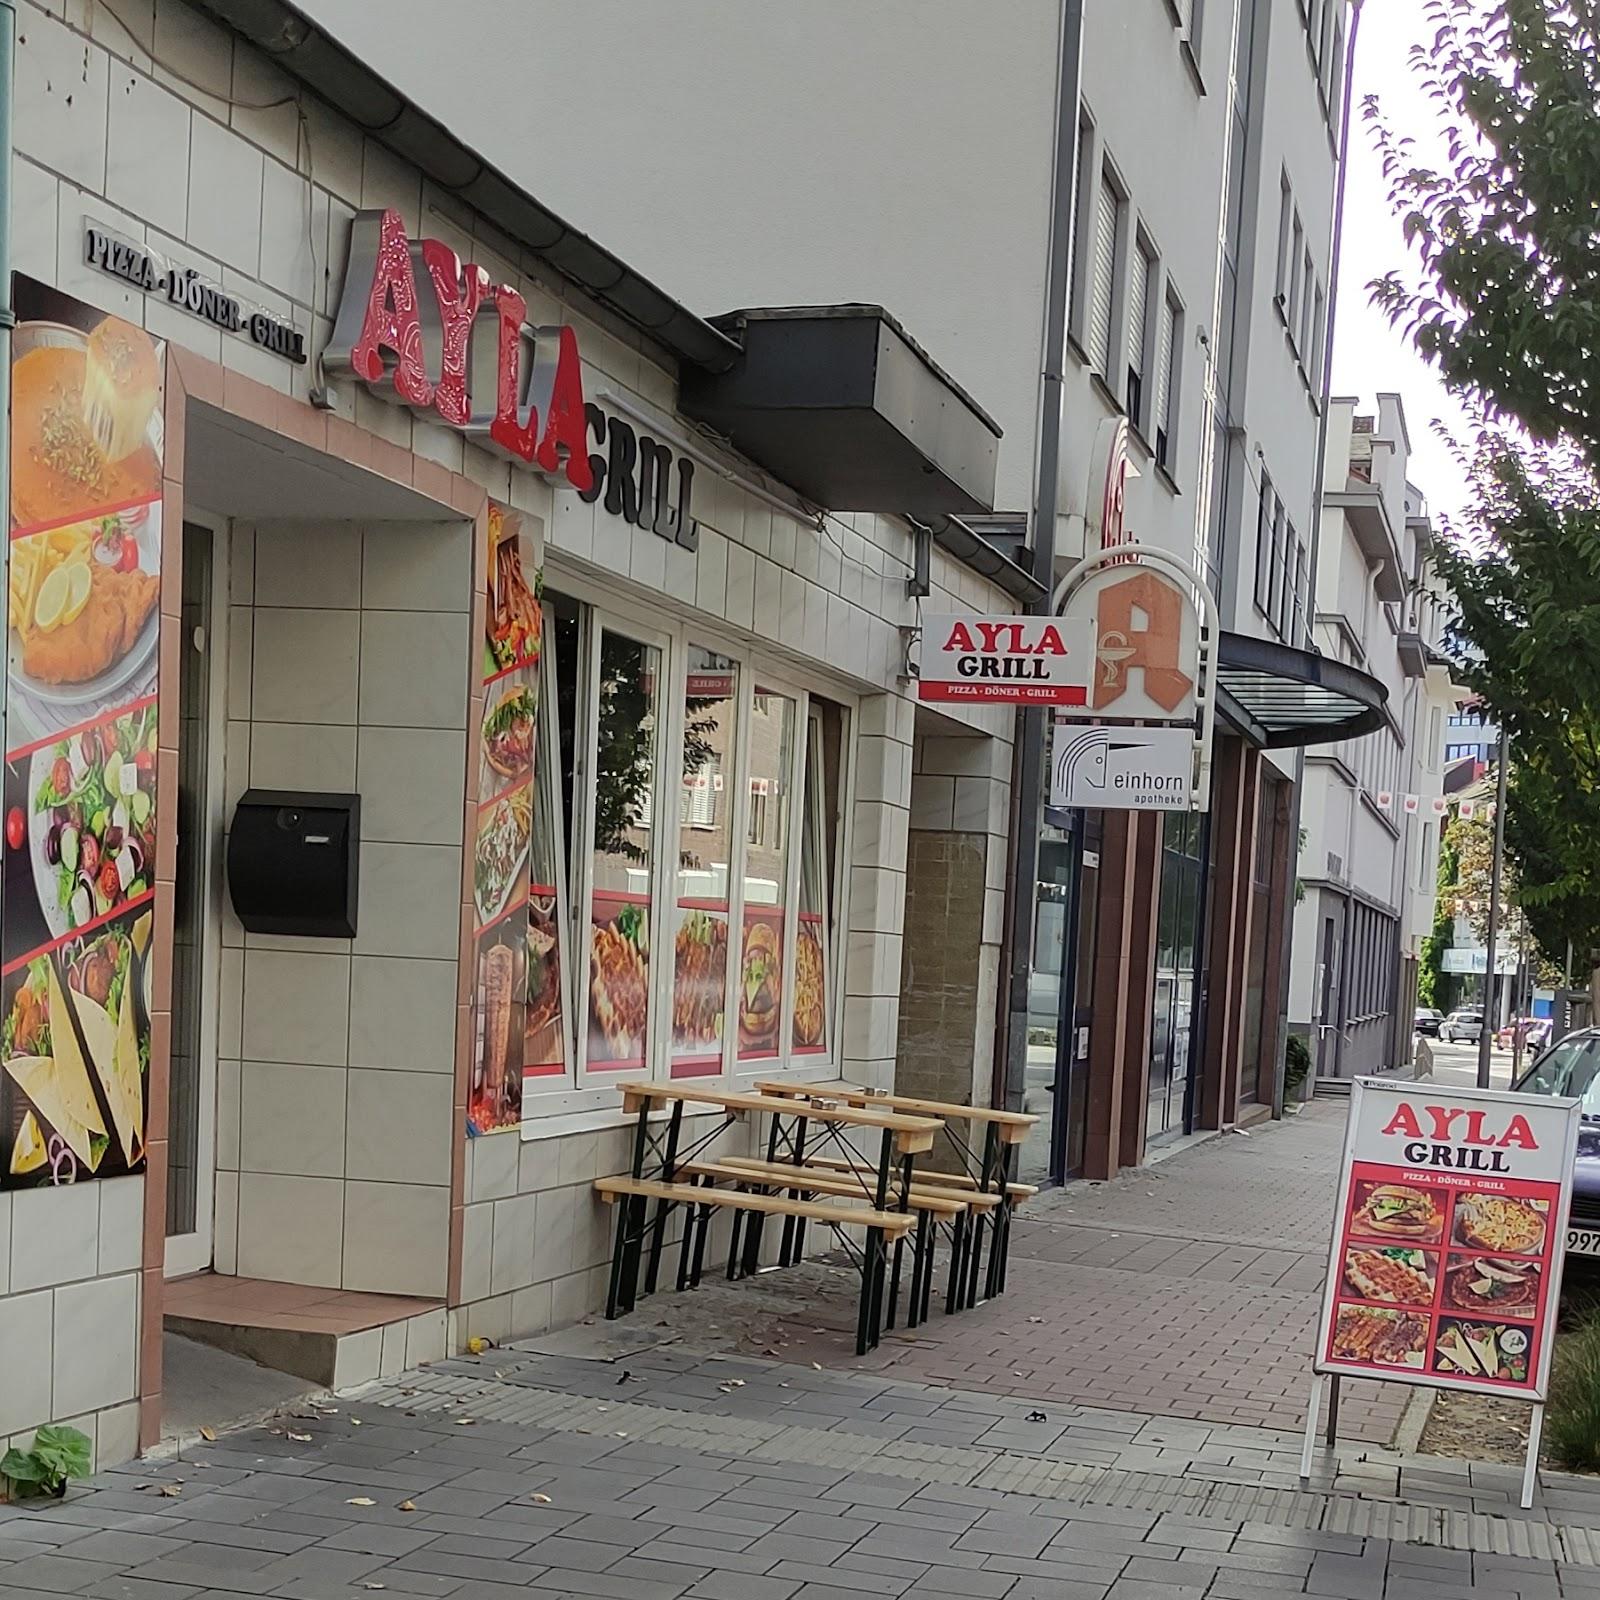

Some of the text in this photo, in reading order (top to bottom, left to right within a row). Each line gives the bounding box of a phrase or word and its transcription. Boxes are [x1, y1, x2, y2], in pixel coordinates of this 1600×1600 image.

[88, 229, 307, 364] PIZZA DÖNER GRILL
[347, 208, 593, 491] AYLA
[577, 402, 699, 552] GRILL
[942, 621, 1068, 655] AYLA
[957, 656, 1050, 679] GRILL
[948, 685, 1057, 698] PIZZA DÖNER GRILL
[1114, 771, 1183, 790] einhorn
[1134, 794, 1183, 804] apotheke
[1381, 1103, 1539, 1149] AYLA
[1404, 1143, 1510, 1172] GRILL
[1403, 1172, 1505, 1190] PIZZA DÖNER GRILL
[1567, 1231, 1600, 1252] 997
